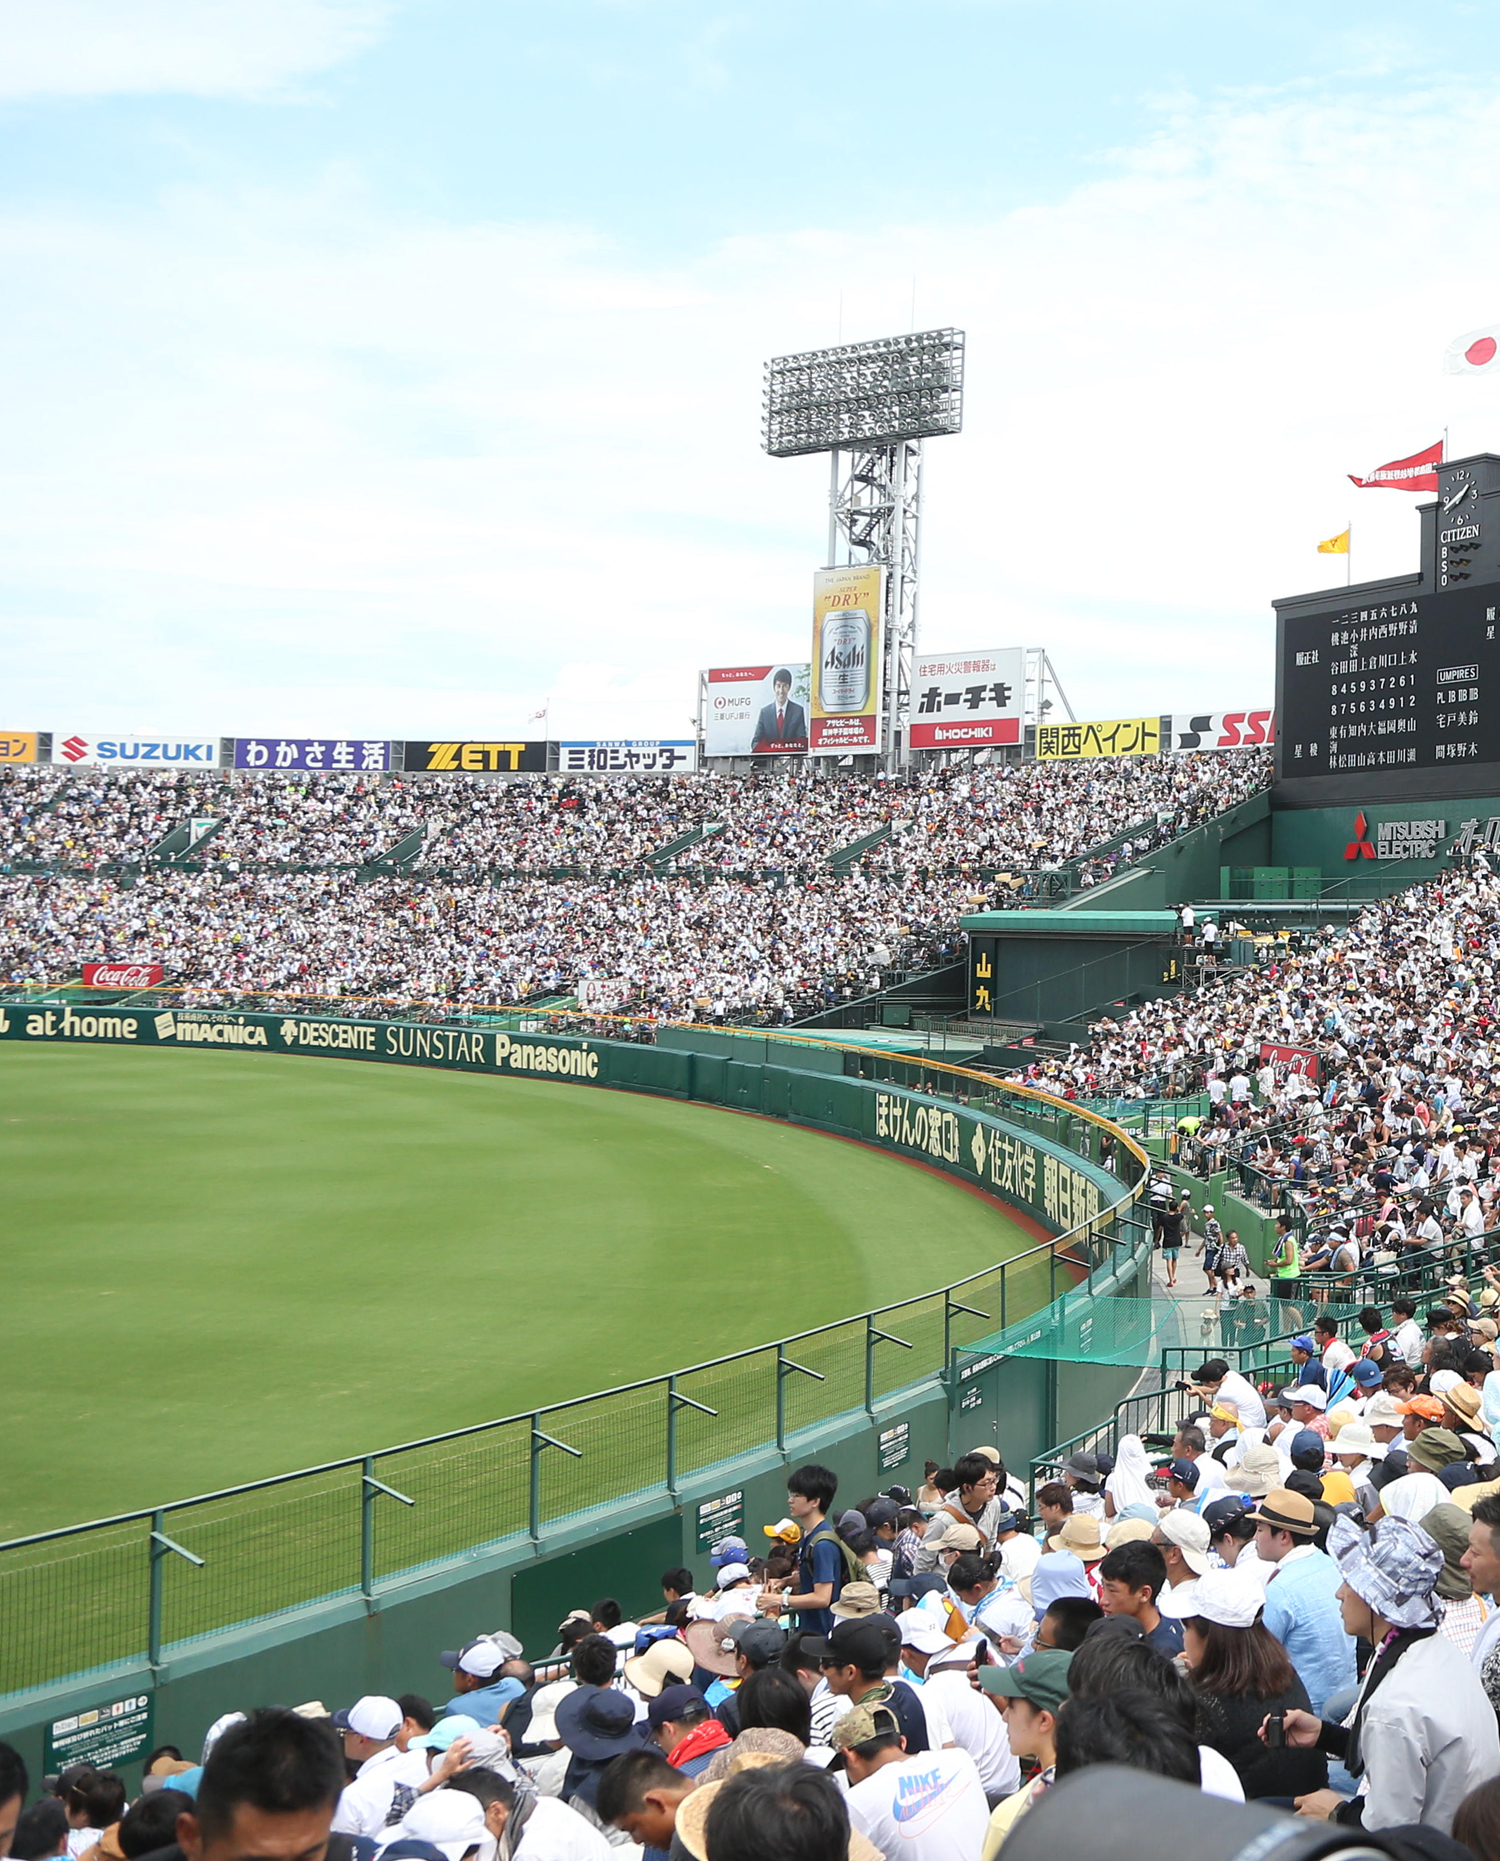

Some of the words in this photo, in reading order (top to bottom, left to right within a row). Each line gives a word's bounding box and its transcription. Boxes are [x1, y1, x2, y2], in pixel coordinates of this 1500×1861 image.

[1456, 470, 1465, 481] 12
[1471, 490, 1478, 499] 3
[1457, 516, 1464, 525] 6
[1440, 524, 1480, 544] CITIZEN
[1441, 547, 1448, 558] B
[1441, 561, 1448, 573] S
[835, 575, 851, 583] JAPAN
[853, 573, 870, 581] BRAND
[825, 644, 864, 670] Asahi
[919, 659, 997, 677] 住宅用火災警報器は
[1439, 667, 1476, 682] UMPIRES
[727, 697, 751, 706] MUFG
[918, 682, 1012, 713] ホーチキ
[714, 711, 750, 720] 三菱UFJ銀行
[943, 727, 993, 740] HOCHIKI
[1039, 721, 1157, 757] 関西ペイント
[97, 741, 213, 761] SUZUKI
[246, 741, 384, 769] わかさ生活
[427, 743, 526, 770] ZETT
[567, 749, 687, 770] 三和シャッター
[1378, 820, 1445, 840] MITSUBISHI
[1377, 840, 1436, 859] ELECTRIC
[92, 965, 153, 988] Coca-Cola
[976, 952, 992, 1012] 山九
[300, 1022, 376, 1051] DESCENTE
[386, 1026, 485, 1064] SUNSTAR
[496, 1033, 598, 1078] Panasonic
[875, 1092, 955, 1163] ほけんの窓口
[988, 1129, 1036, 1204] 住友化学
[898, 1767, 942, 1800] NIKE
